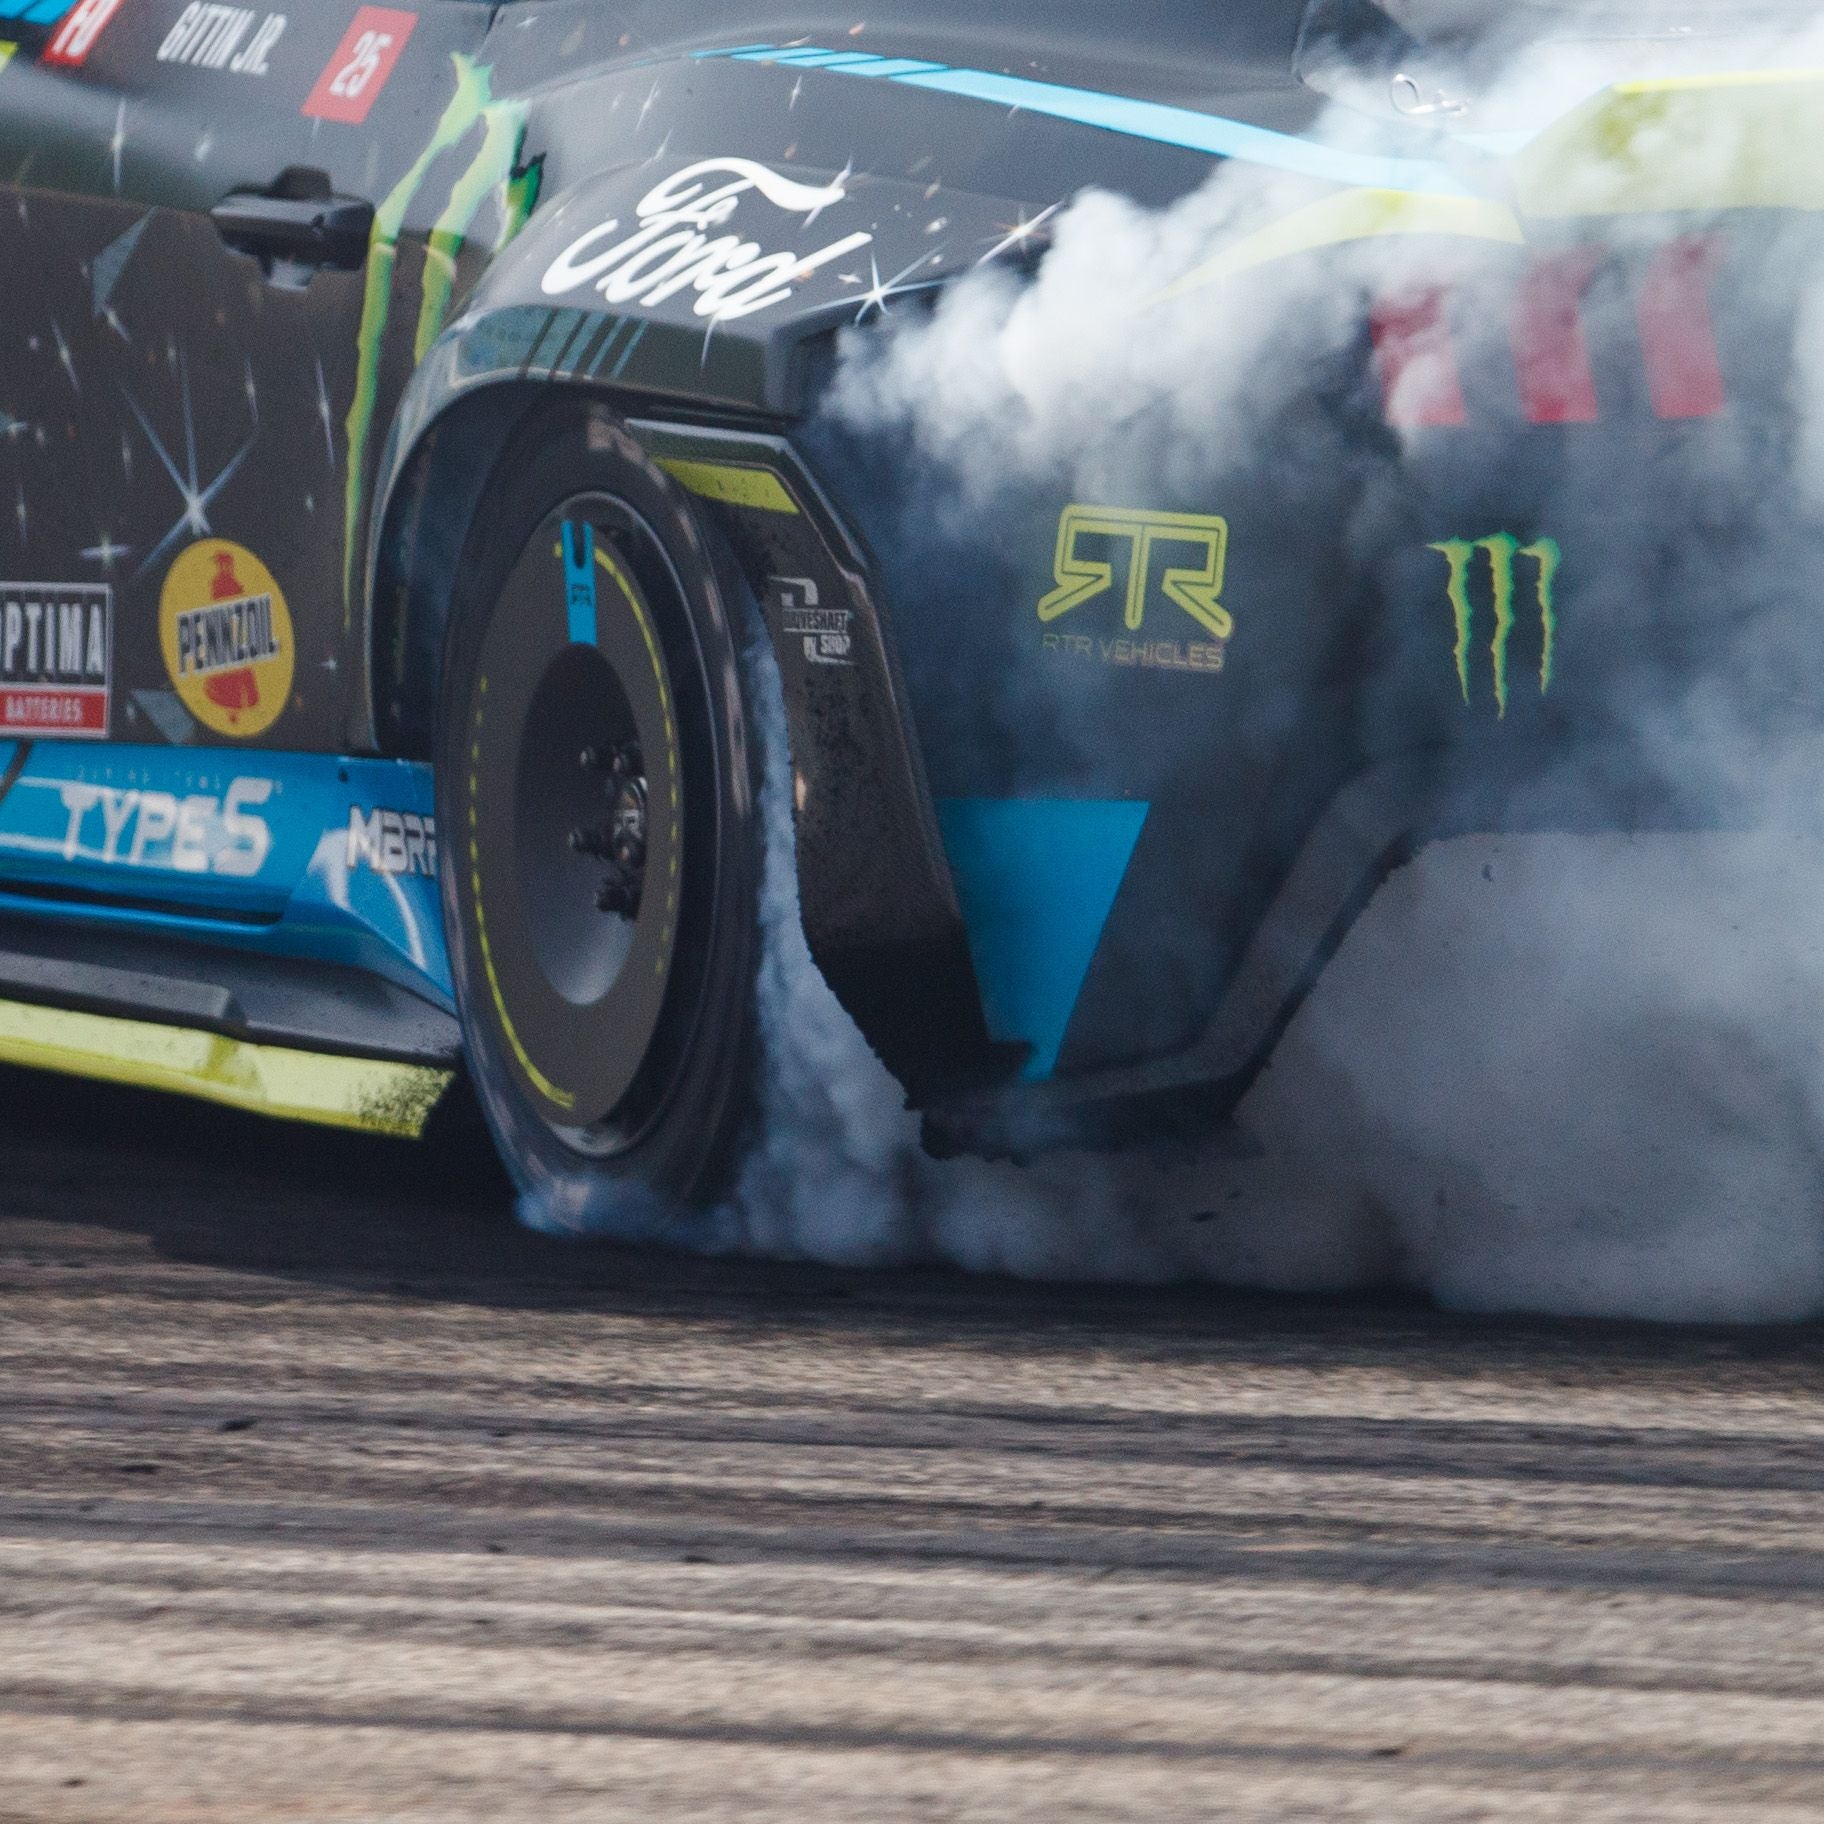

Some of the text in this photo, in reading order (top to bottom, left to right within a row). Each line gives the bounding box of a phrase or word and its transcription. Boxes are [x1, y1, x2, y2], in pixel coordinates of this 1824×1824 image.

[329, 29, 393, 98] 25
[541, 157, 873, 320] Ford
[1037, 504, 1233, 638] RTR
[177, 595, 277, 674] PENNZOIL
[1097, 639, 1224, 673] VEHICLES
